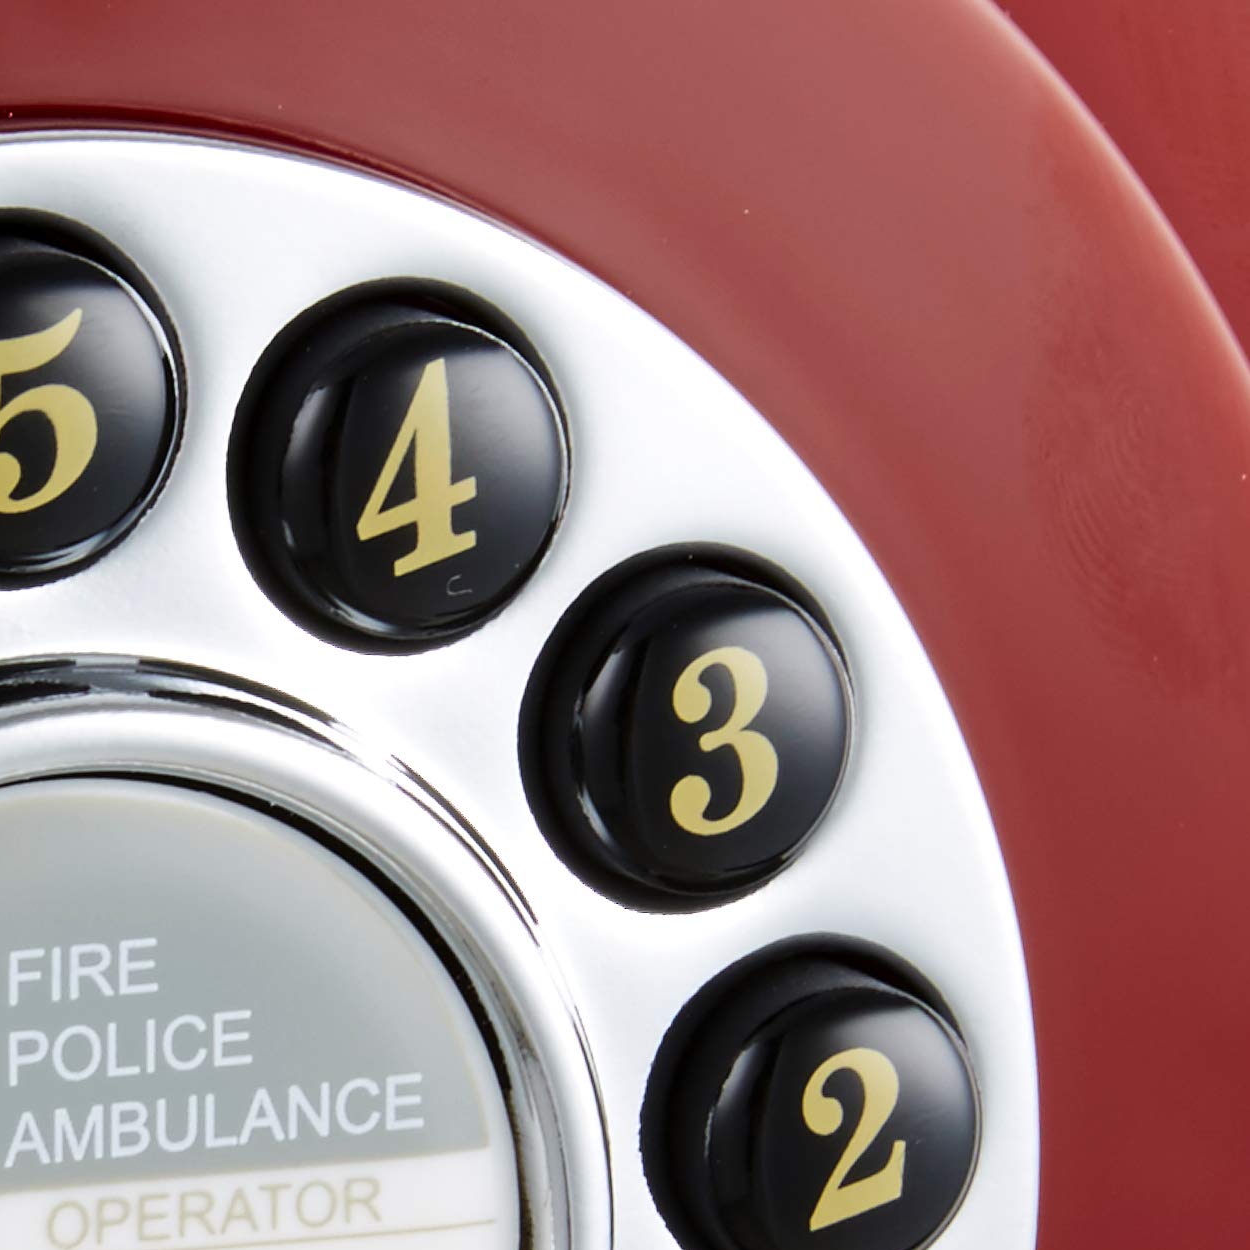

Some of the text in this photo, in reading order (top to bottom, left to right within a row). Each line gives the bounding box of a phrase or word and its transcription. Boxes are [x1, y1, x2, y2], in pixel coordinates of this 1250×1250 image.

[356, 358, 478, 578] 4
[669, 645, 779, 838] 3
[8, 936, 159, 1006] FIRE
[7, 1009, 254, 1086] POLICE
[3, 1071, 426, 1170] AMBULANCE
[801, 1045, 908, 1233] 2
